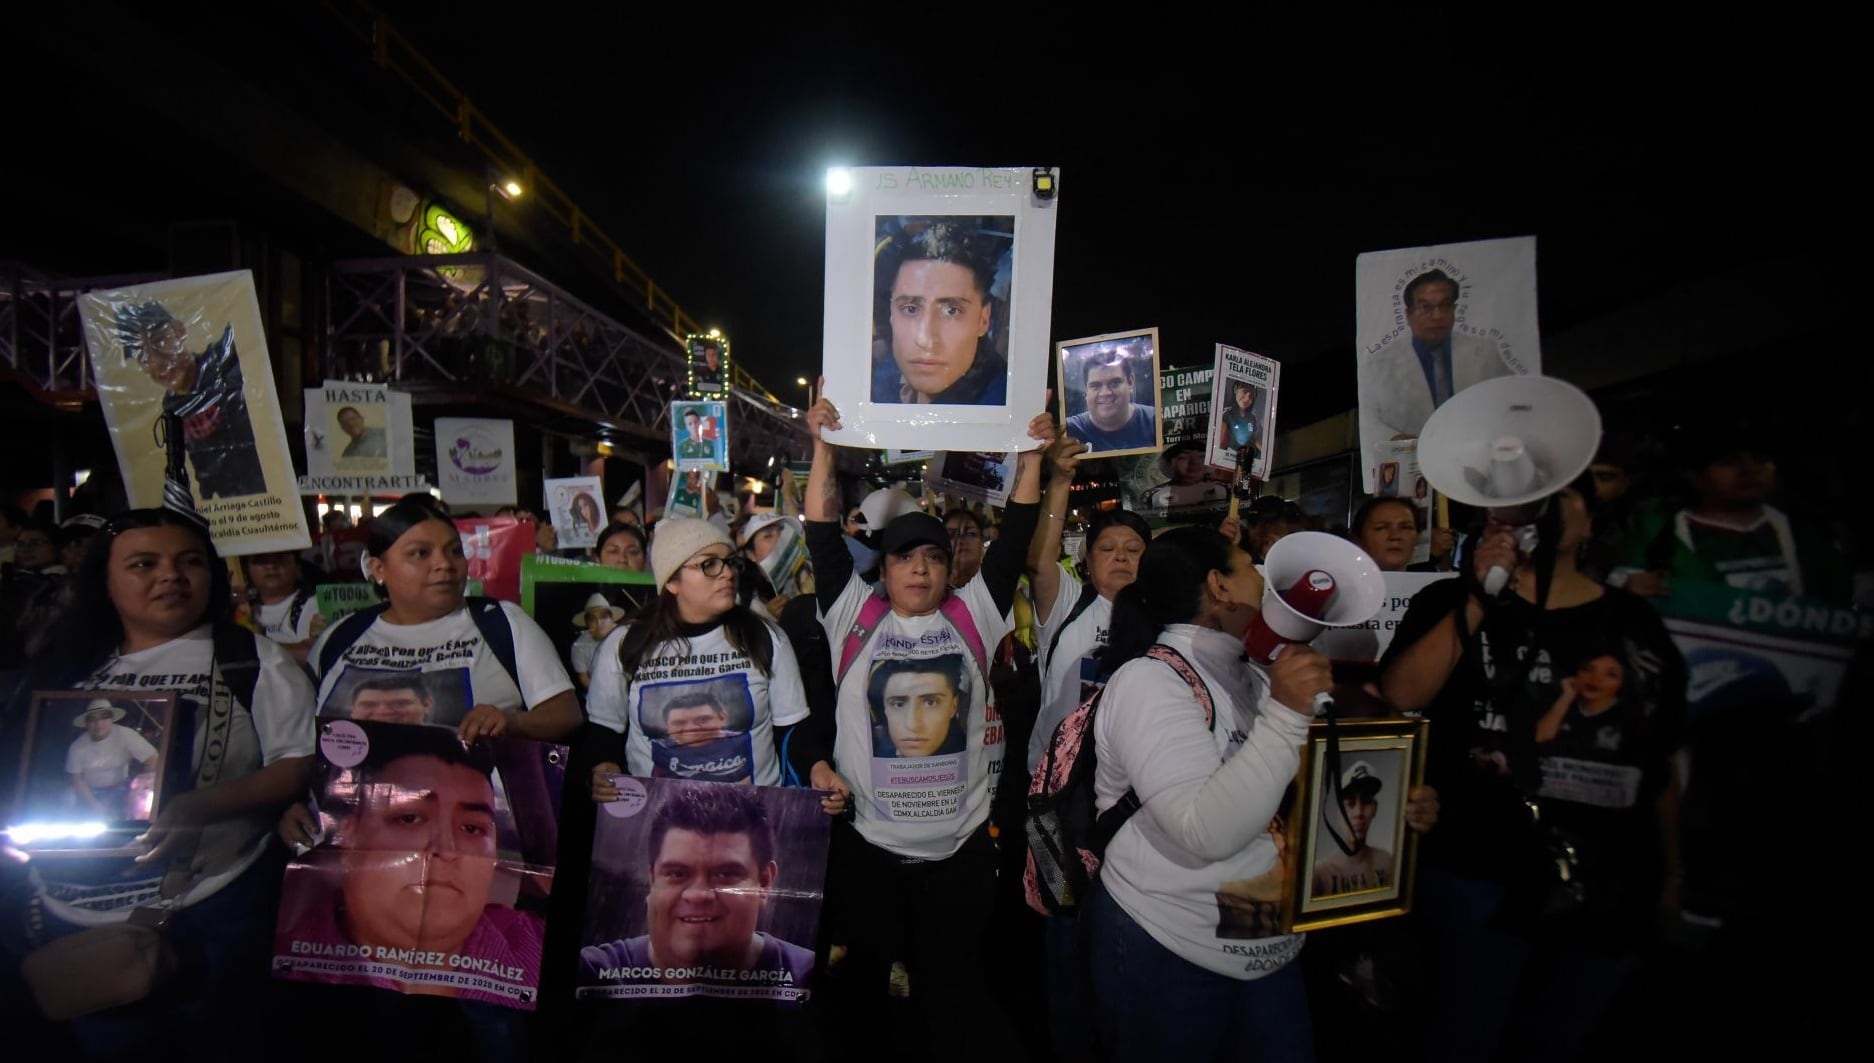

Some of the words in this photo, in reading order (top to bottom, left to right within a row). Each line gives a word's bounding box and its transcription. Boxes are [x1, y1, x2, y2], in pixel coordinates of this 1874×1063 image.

[1226, 352, 1243, 364] KARLA
[1229, 361, 1244, 375] TELA
[1246, 366, 1267, 381] FLORES
[1160, 374, 1175, 390] CO
[1177, 368, 1213, 388] CAMP
[325, 389, 386, 403] HASTA
[1175, 387, 1192, 402] EN
[247, 496, 282, 508] Castillo
[236, 513, 248, 523] de
[249, 510, 280, 522] agosto
[1391, 596, 1410, 612] po
[700, 652, 718, 664] QUE
[720, 652, 730, 662] TE
[671, 665, 716, 678] González
[718, 660, 752, 674] García
[139, 674, 169, 688] QUE
[171, 674, 187, 685] TE
[187, 673, 213, 685] AM
[203, 679, 229, 783] COACH
[891, 774, 955, 785] #TEBUSCAMOSJESUS
[878, 790, 927, 799] DESAPARECIDO
[891, 799, 901, 808] DE
[902, 800, 940, 808] NOVIEMBRE
[950, 796, 958, 805] LA
[290, 940, 372, 958] EDUARDO
[375, 947, 446, 966] RAMÍREZ
[448, 953, 525, 982] GONZÁLEZ
[358, 965, 370, 973] EL
[372, 965, 384, 975] 20
[386, 967, 397, 976] DE
[399, 970, 455, 984] SEPTIEMBRE
[457, 976, 470, 986] DE
[472, 978, 493, 990] 2020
[494, 983, 505, 992] EN
[599, 967, 662, 981] MARCOS
[664, 963, 737, 982] GONZÁLEZ
[739, 967, 795, 983] GARCÍA
[661, 987, 672, 995] 20
[673, 987, 685, 995] DE
[772, 989, 783, 997] EN
